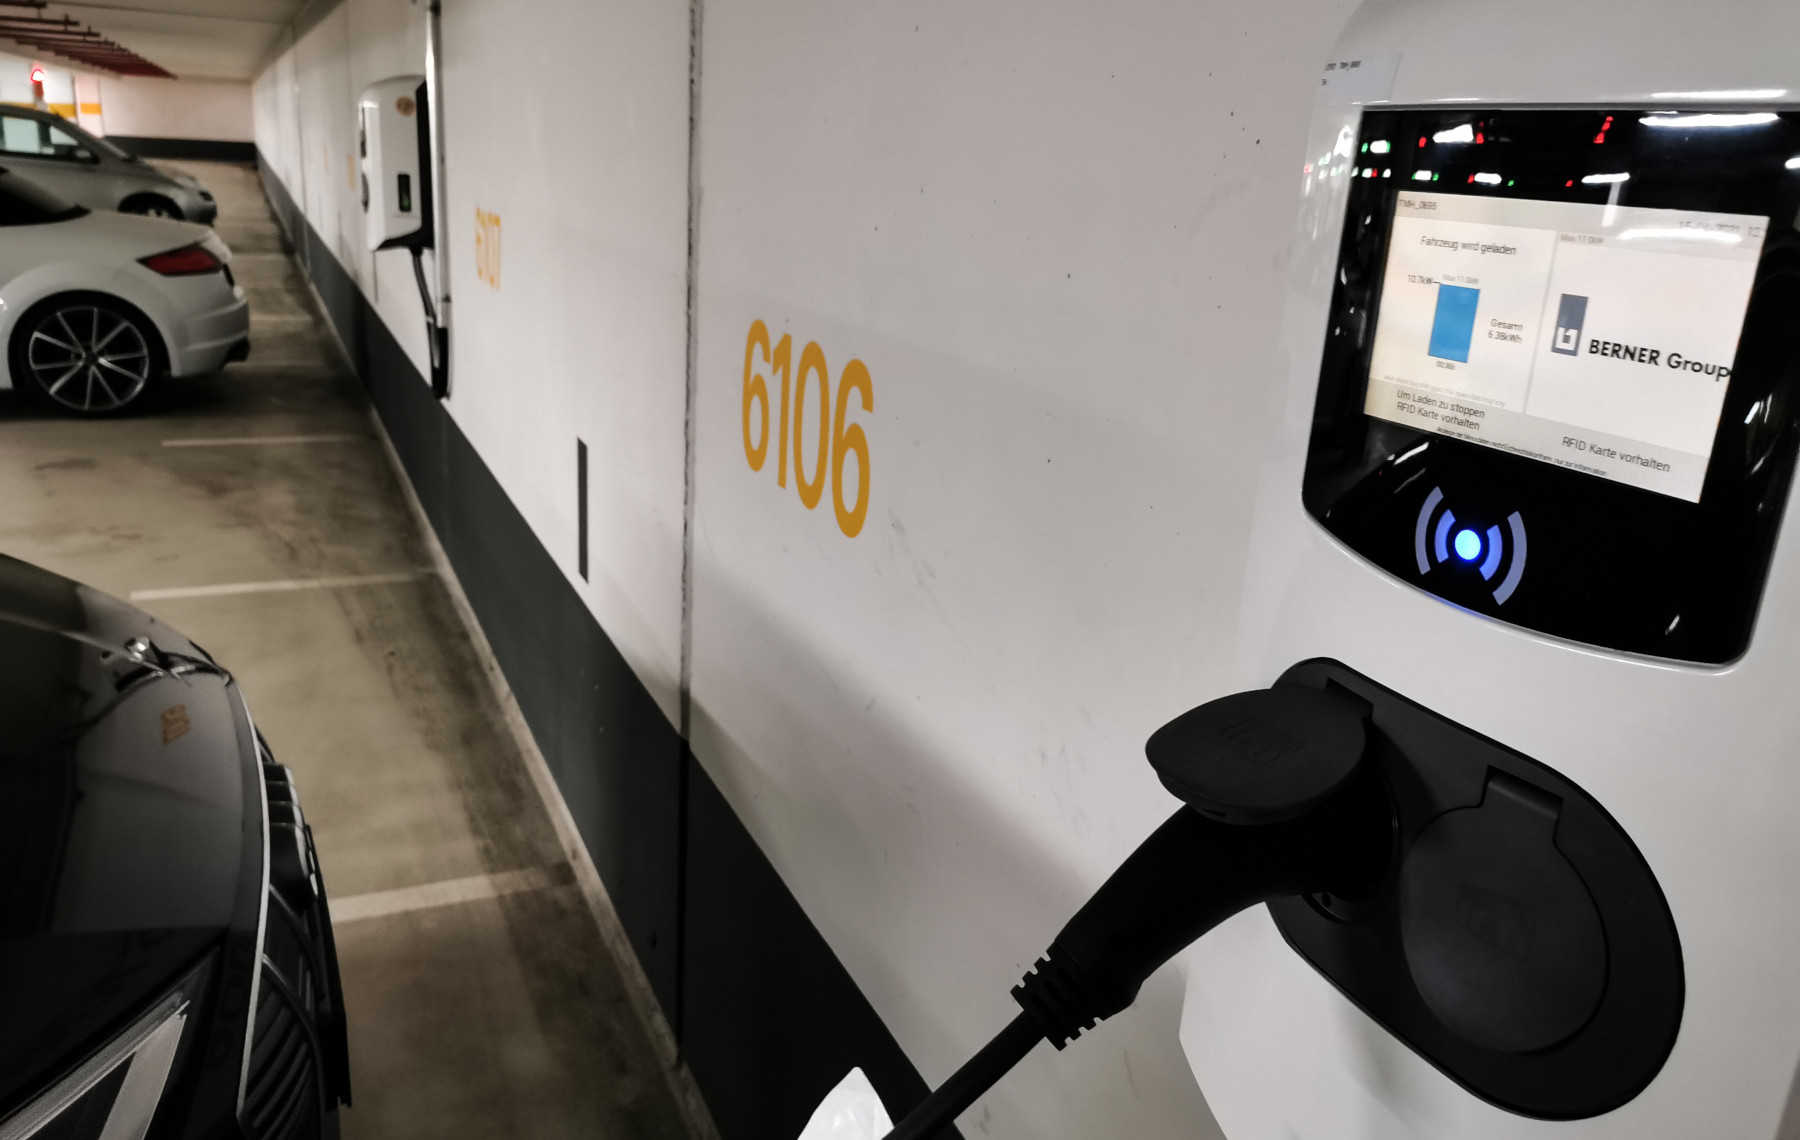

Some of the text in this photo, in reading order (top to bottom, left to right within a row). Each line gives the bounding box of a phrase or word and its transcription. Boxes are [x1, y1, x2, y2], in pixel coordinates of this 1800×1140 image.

[1420, 235, 1517, 256] Fahrzeug wird geladen
[1487, 330, 1523, 344] 6.38kWh
[1490, 318, 1524, 332] Gesamt
[1588, 339, 1732, 382] BERNER Group
[1396, 389, 1411, 401] Um
[1412, 392, 1437, 408] Laden
[1438, 399, 1450, 410] zu
[1449, 401, 1486, 420] stoppen
[1396, 401, 1480, 431] RFID Karte vorhalten
[741, 318, 874, 538] 6106
[1561, 435, 1671, 473] RFID Karte vorhalten
